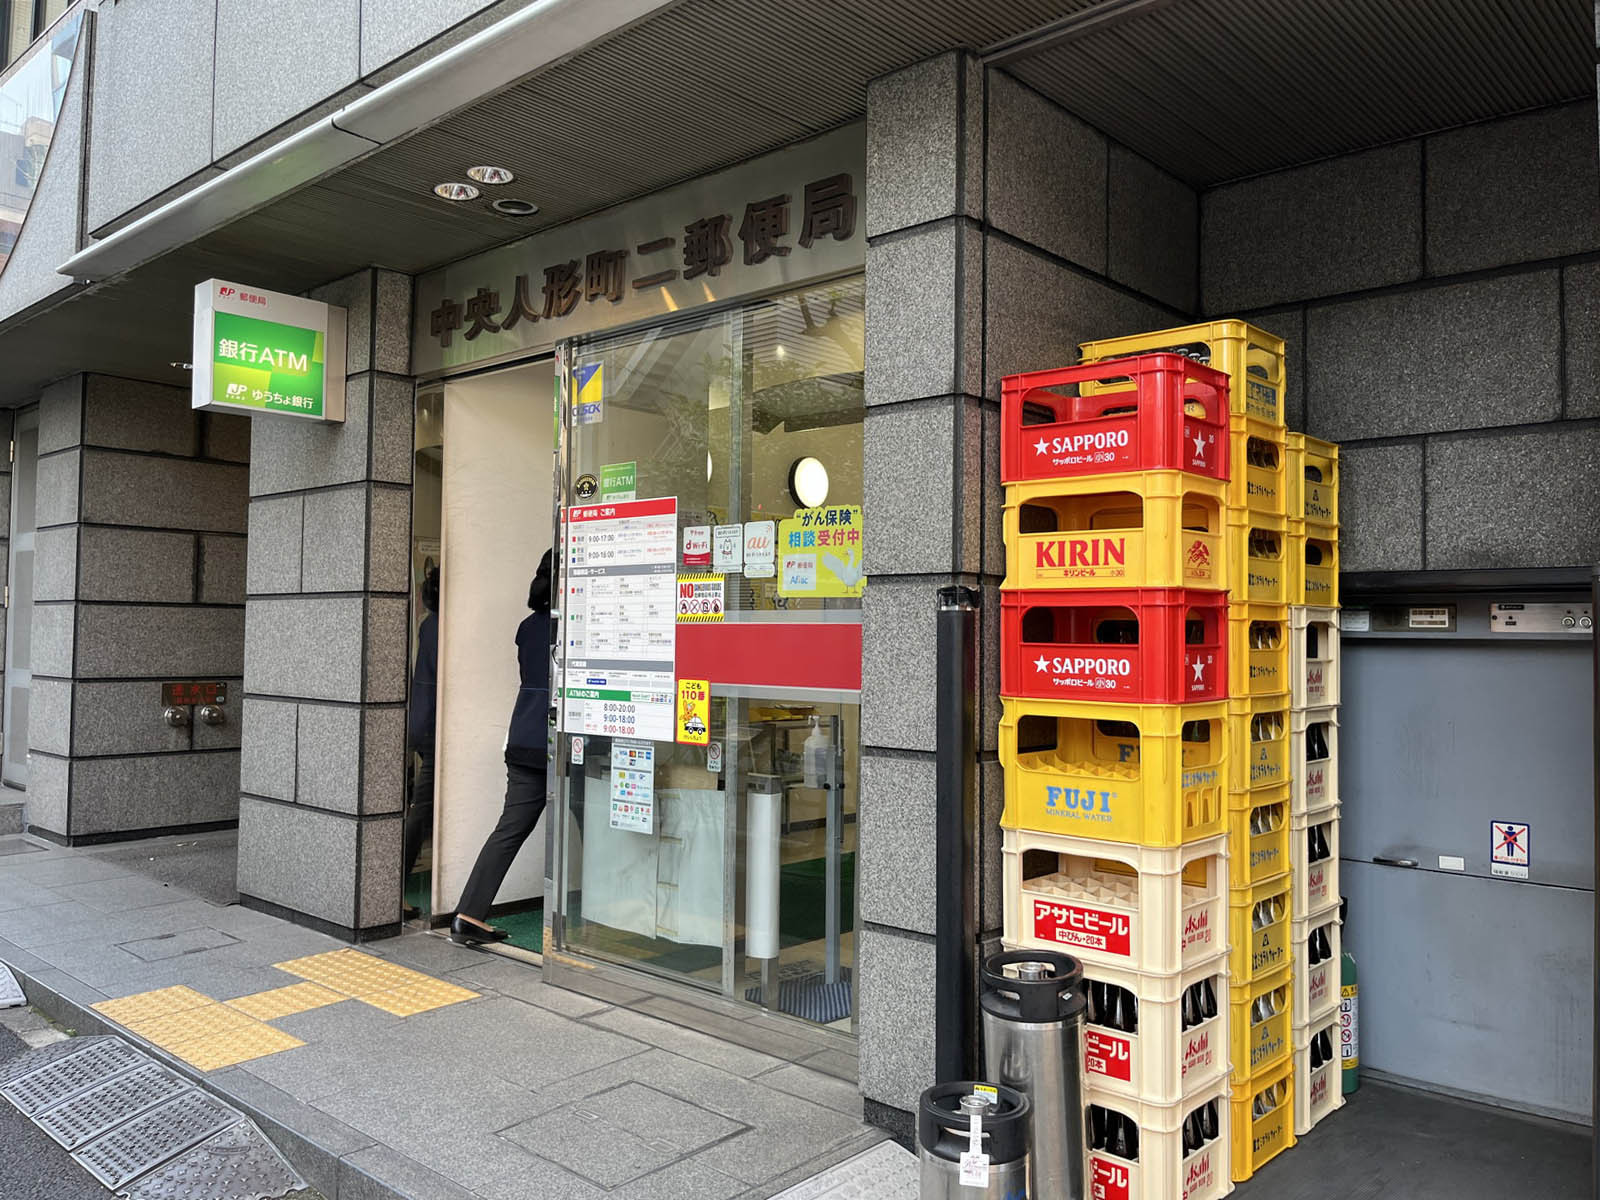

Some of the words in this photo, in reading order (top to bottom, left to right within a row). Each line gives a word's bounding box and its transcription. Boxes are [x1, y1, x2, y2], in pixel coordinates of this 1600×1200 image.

[430, 172, 858, 348] 中央人形町二郵便局
[219, 338, 308, 372] 銀行ATM
[252, 389, 314, 409] ゆうちょ銀行
[1052, 430, 1129, 454] SAPPORO
[1052, 455, 1093, 466] サッポロビール
[746, 536, 770, 550] au
[788, 528, 860, 548] 相談受付中
[1035, 538, 1125, 568] KIRIN
[1063, 568, 1096, 577] キリンビール
[680, 583, 694, 598] NO
[1053, 658, 1130, 675] SAPPORO
[685, 682, 702, 690] こども
[1053, 677, 1094, 688] サッポロビール
[1045, 785, 1111, 813] FUJI
[1045, 806, 1081, 820] MINERAL
[1083, 812, 1113, 822] WATER
[1034, 902, 1130, 936] アサヒビール
[1184, 909, 1209, 935] Asahi
[1185, 1031, 1209, 1060] Asahi
[1186, 1152, 1210, 1185] Asahi
